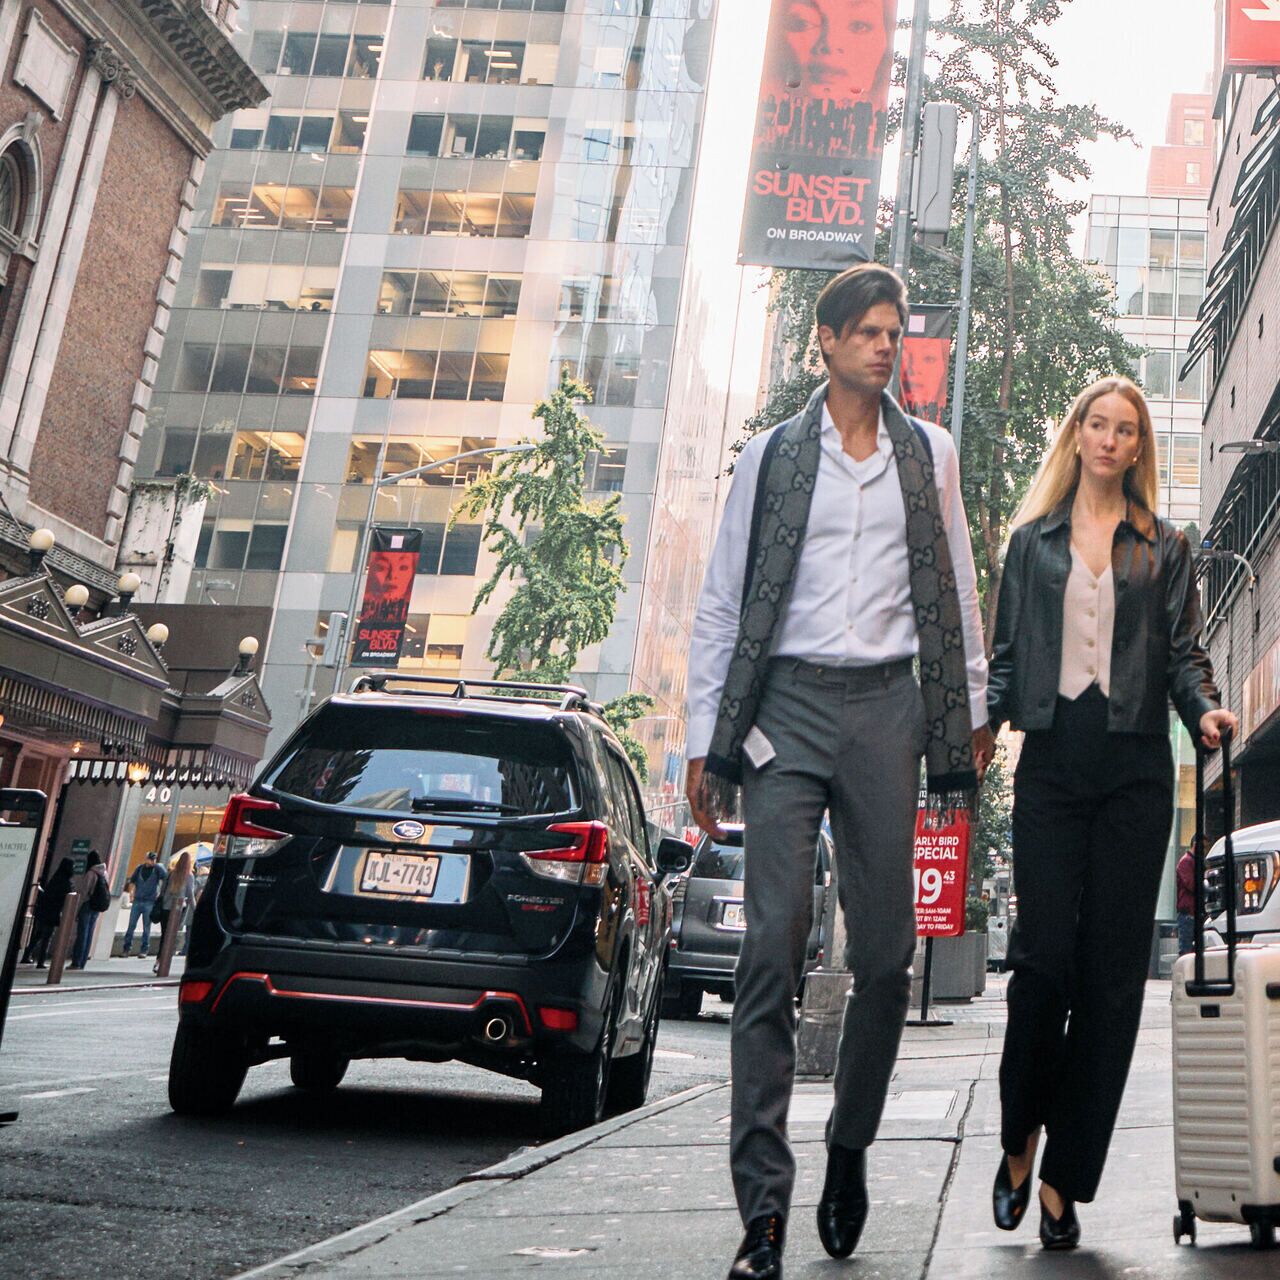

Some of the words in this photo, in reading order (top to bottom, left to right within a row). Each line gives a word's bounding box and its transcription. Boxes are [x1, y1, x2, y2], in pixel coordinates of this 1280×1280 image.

[752, 169, 871, 202] SUNSET
[786, 197, 864, 225] BLVD.
[767, 227, 786, 239] ON
[789, 229, 862, 243] BROADWAY
[360, 629, 401, 640] SUNSET
[145, 786, 171, 803] 40
[915, 836, 937, 845] ARLY
[938, 836, 959, 845] BIRD
[400, 863, 433, 886] 7743
[943, 871, 955, 881] 43
